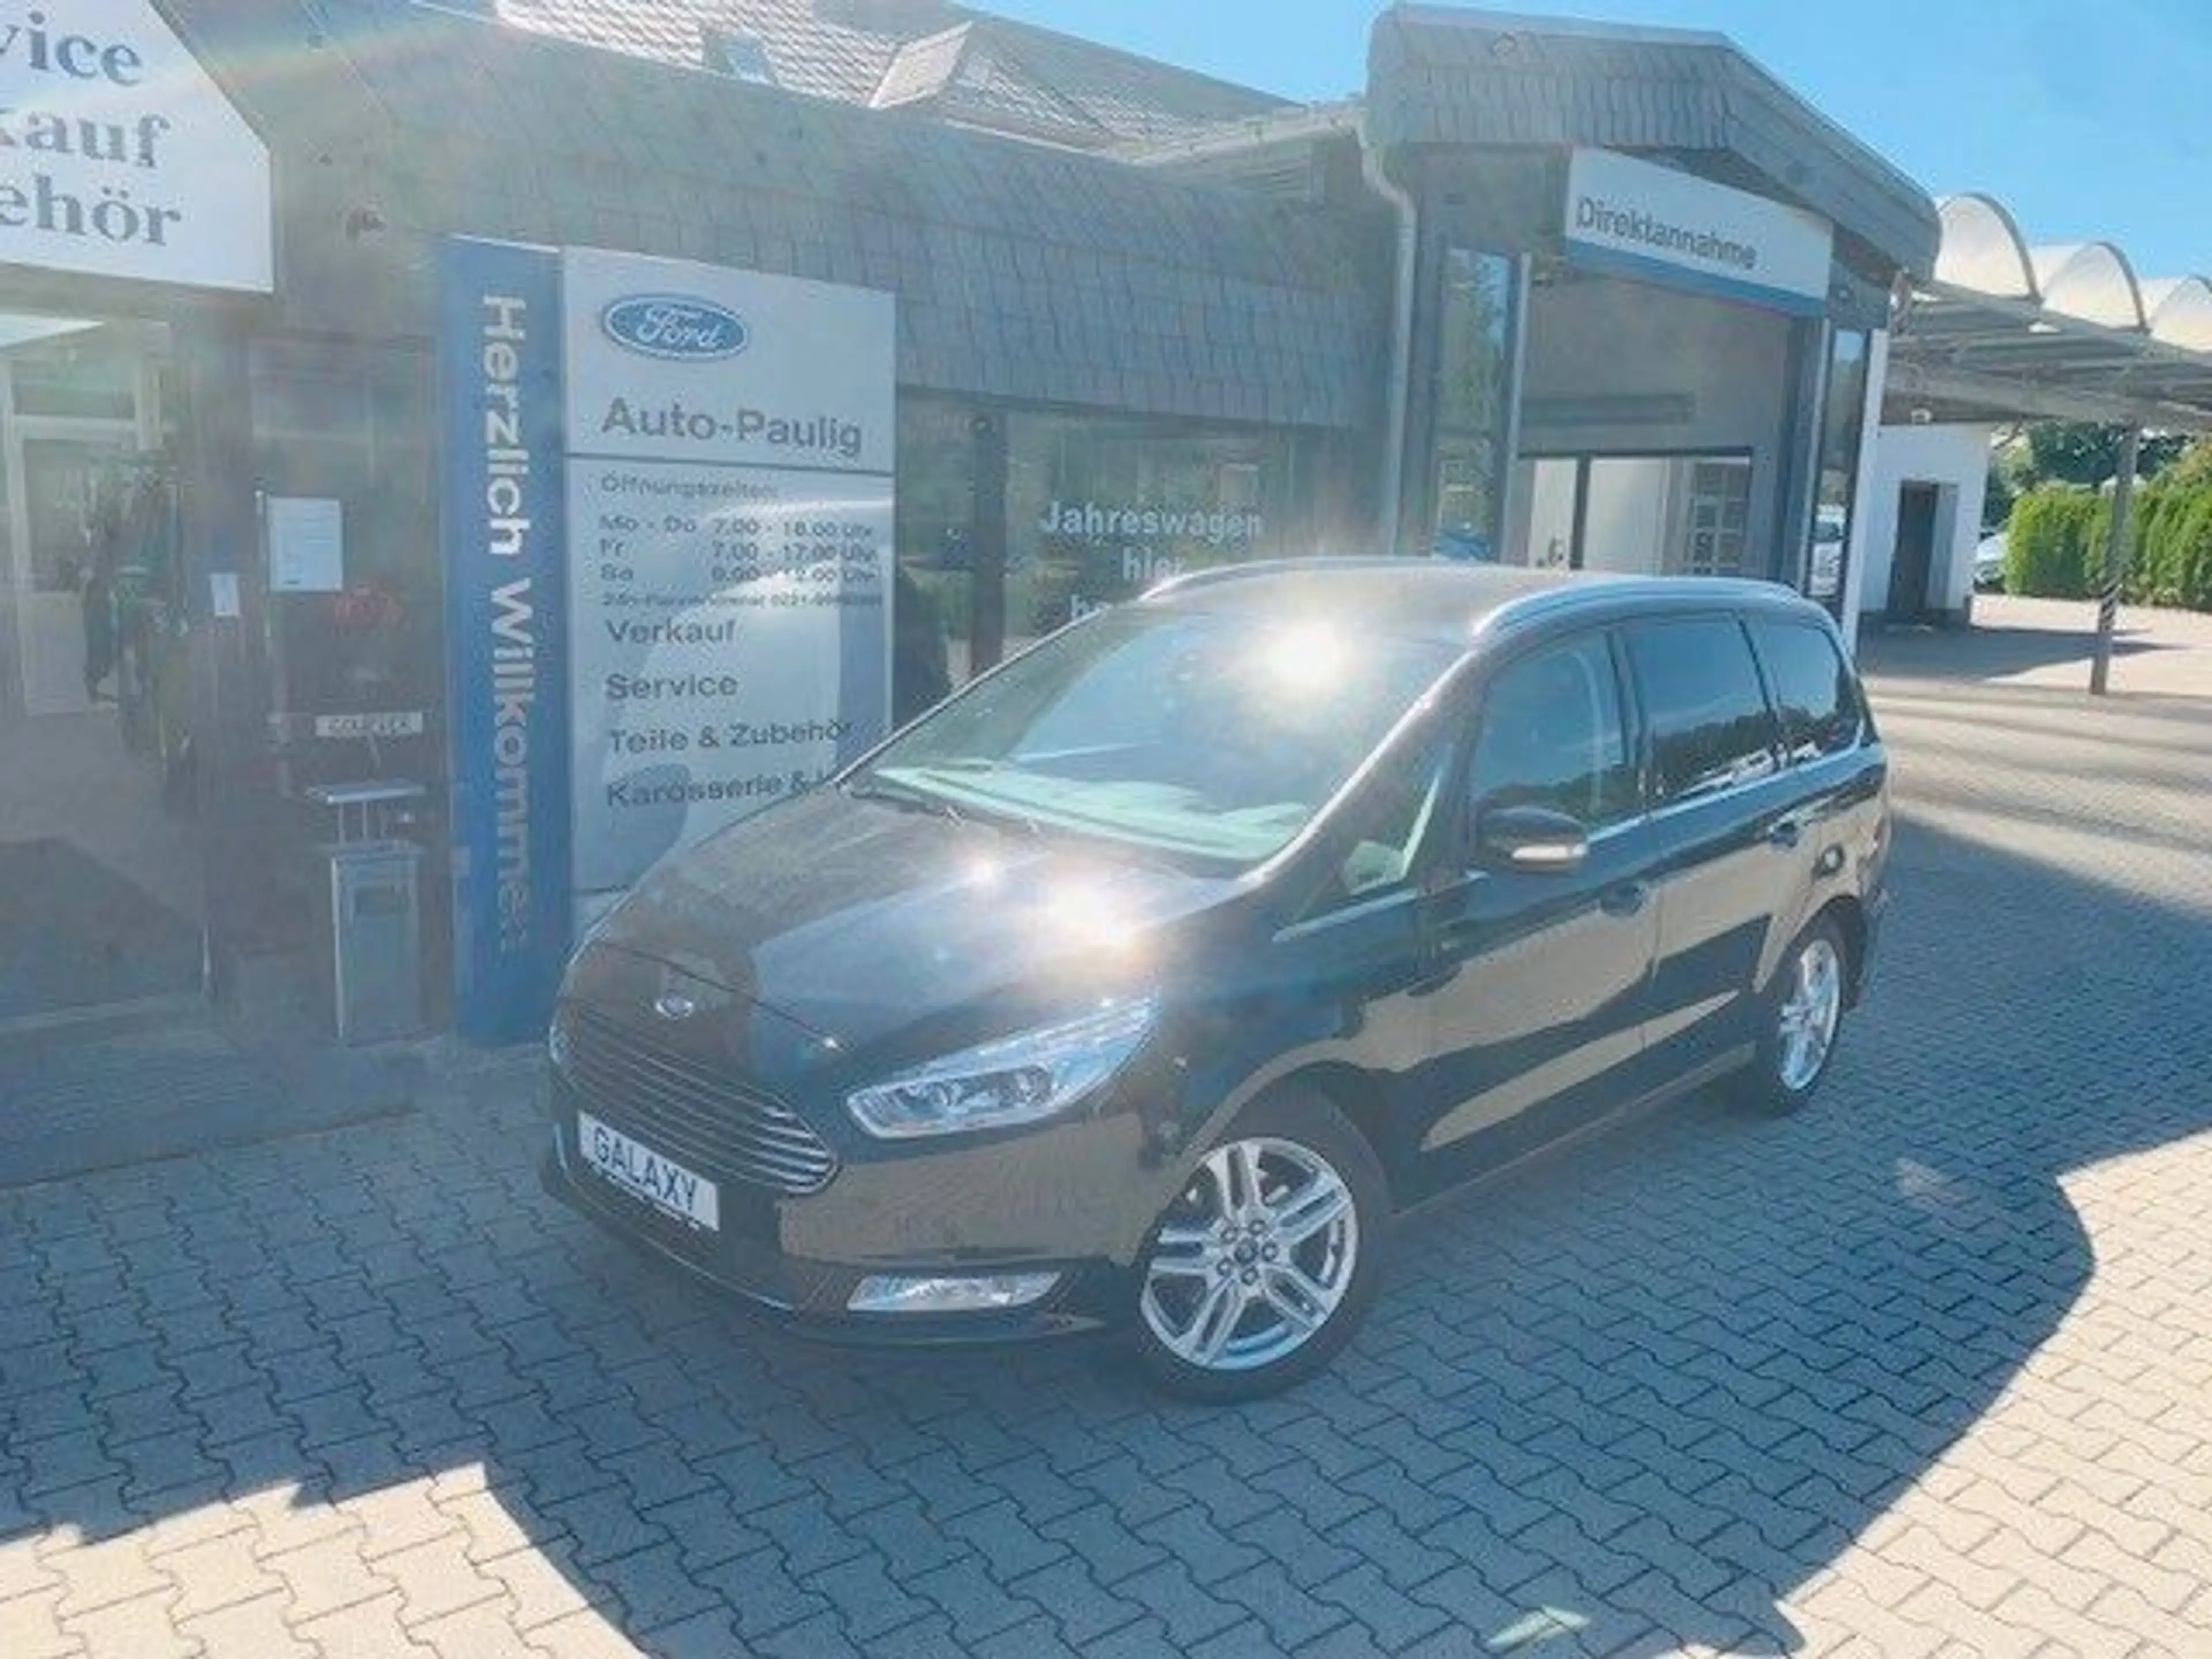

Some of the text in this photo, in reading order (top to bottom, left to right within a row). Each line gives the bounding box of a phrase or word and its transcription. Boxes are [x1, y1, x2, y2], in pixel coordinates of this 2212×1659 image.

[1575, 195, 1759, 270] Direktannahme
[483, 294, 531, 555] Herzlich
[601, 397, 863, 457] Auto-Paulig
[1039, 501, 1264, 543] Jahreswagen
[605, 673, 738, 699] Service
[609, 727, 688, 753] Teile
[698, 725, 720, 748] &
[594, 1126, 698, 1210] GALAXY
